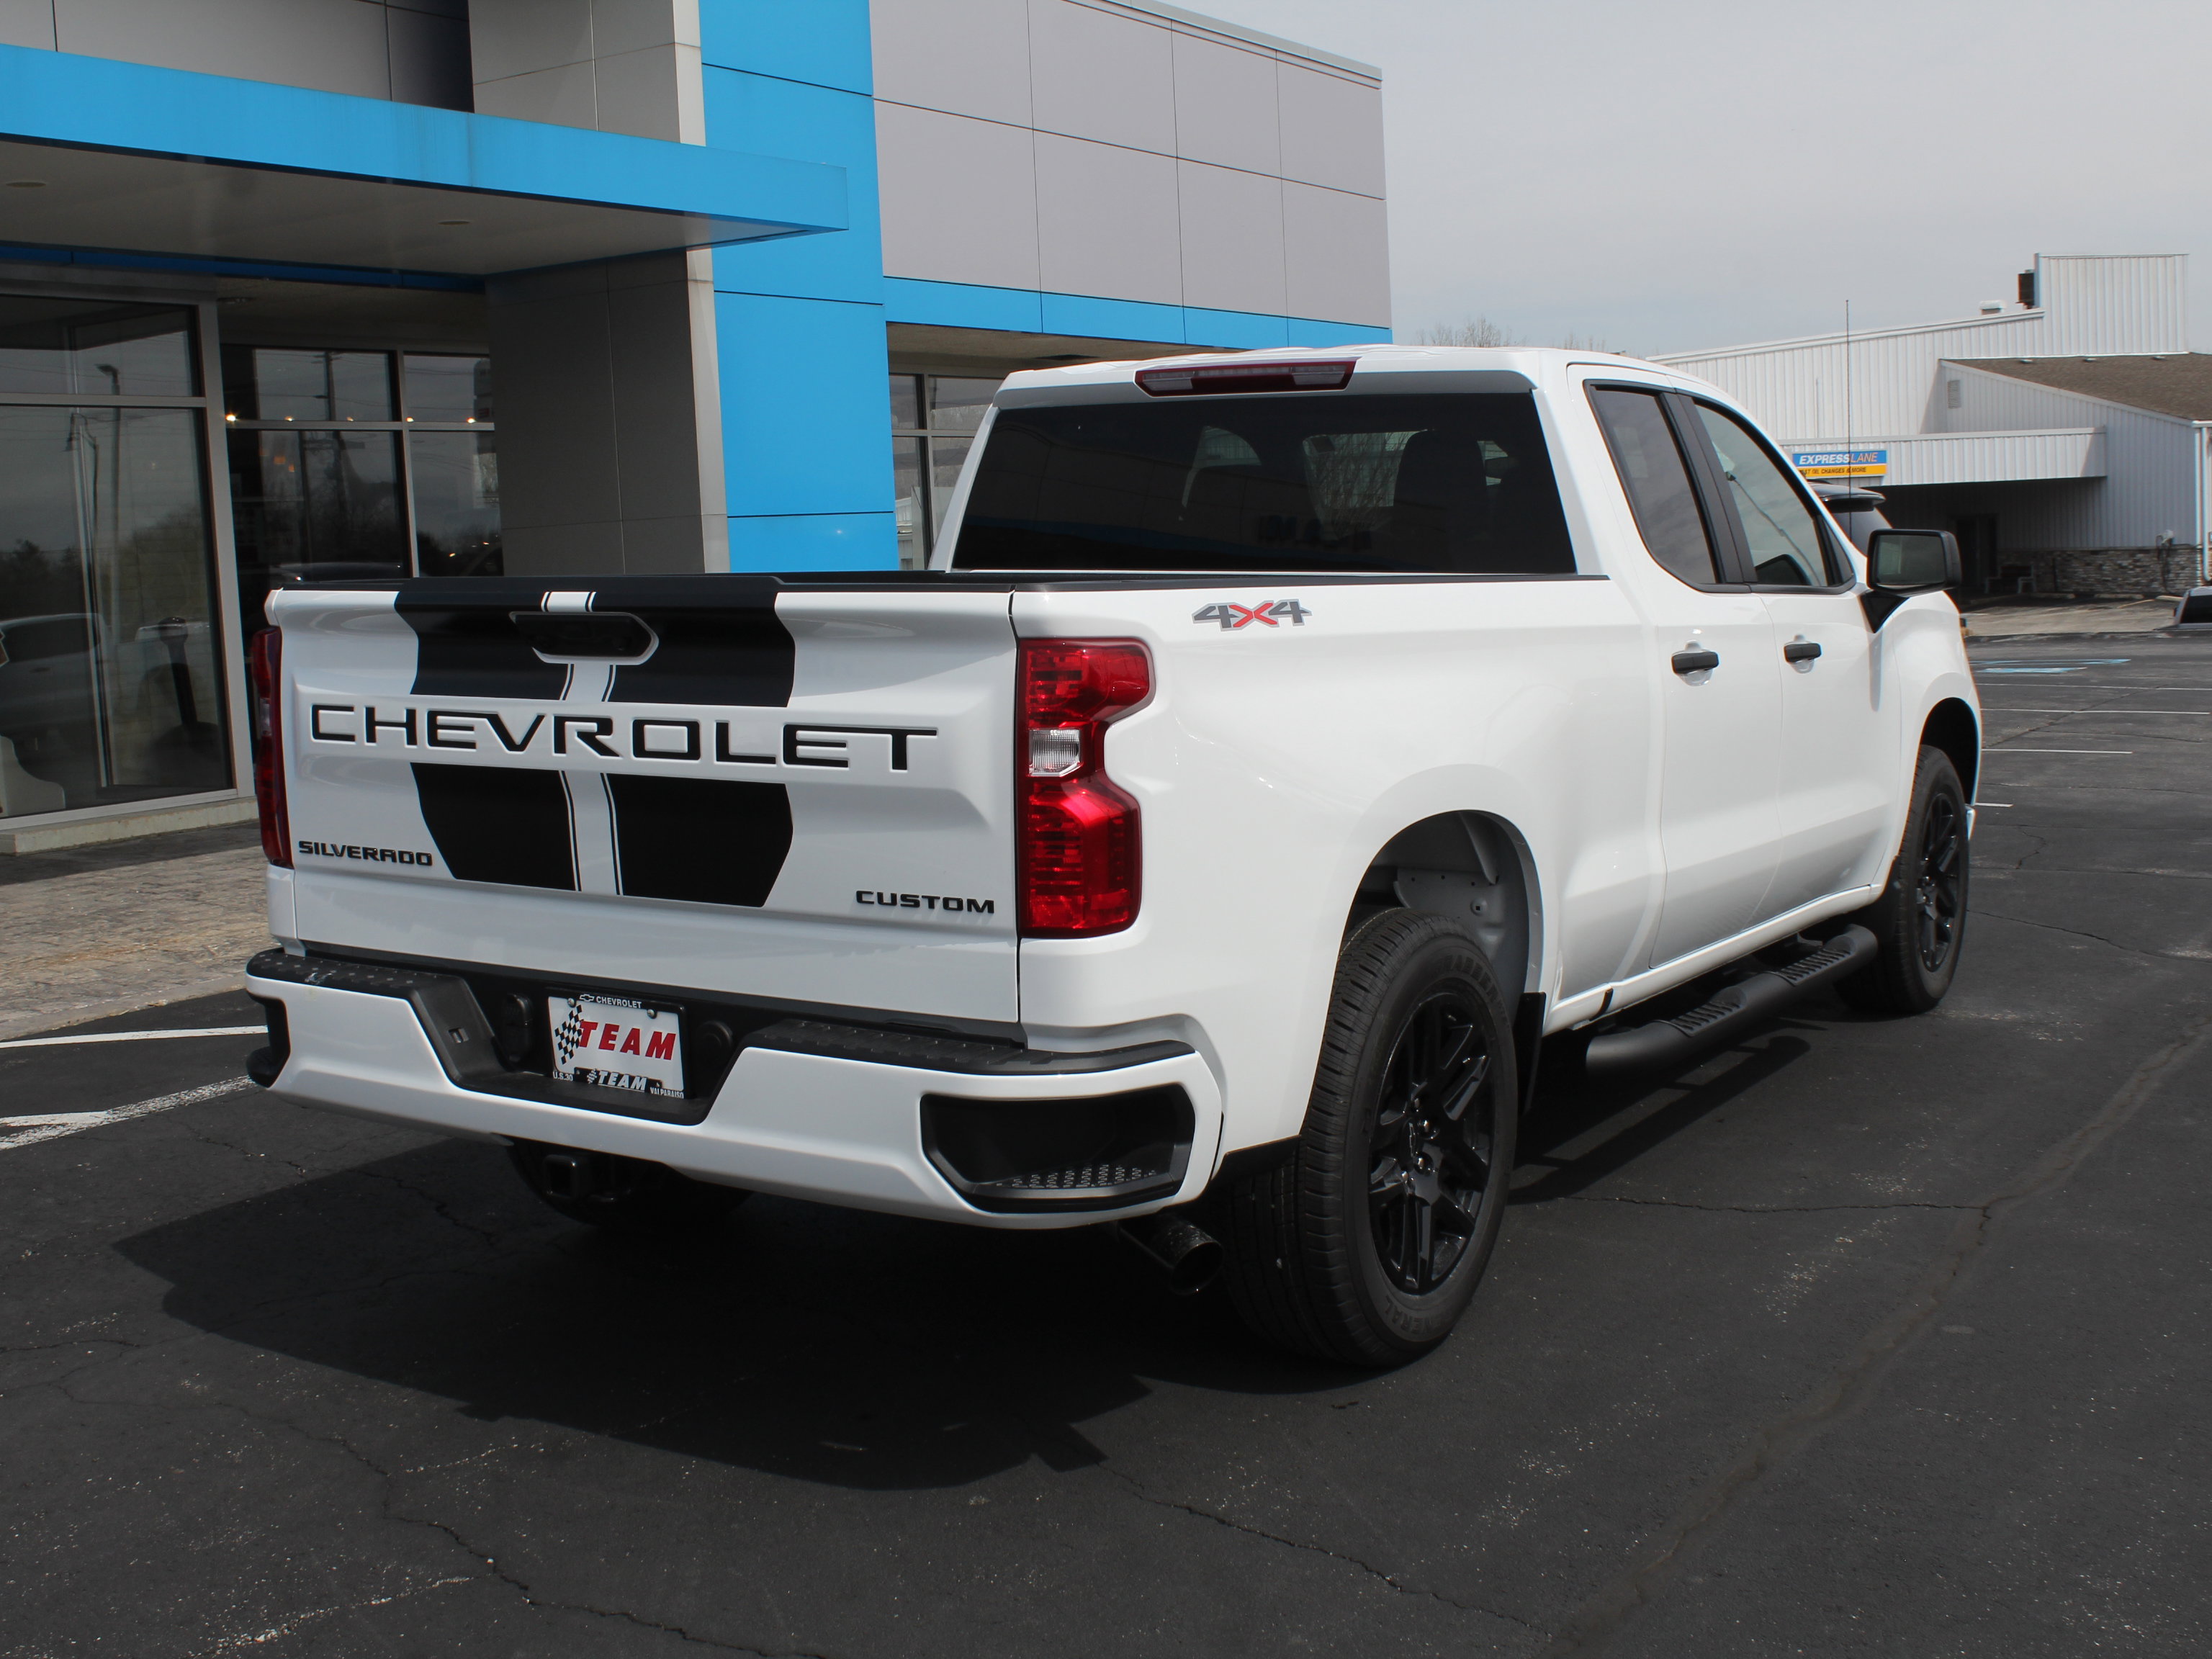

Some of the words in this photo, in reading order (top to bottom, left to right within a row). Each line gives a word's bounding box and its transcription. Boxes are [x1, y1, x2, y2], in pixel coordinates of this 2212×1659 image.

[310, 703, 938, 772] CHEVROLET
[298, 840, 433, 866] SILVERADO
[855, 890, 995, 914] CUSTOM
[596, 996, 642, 1009] CHEVROLET
[578, 1020, 677, 1061] TEAM
[598, 1070, 648, 1091] TEAM
